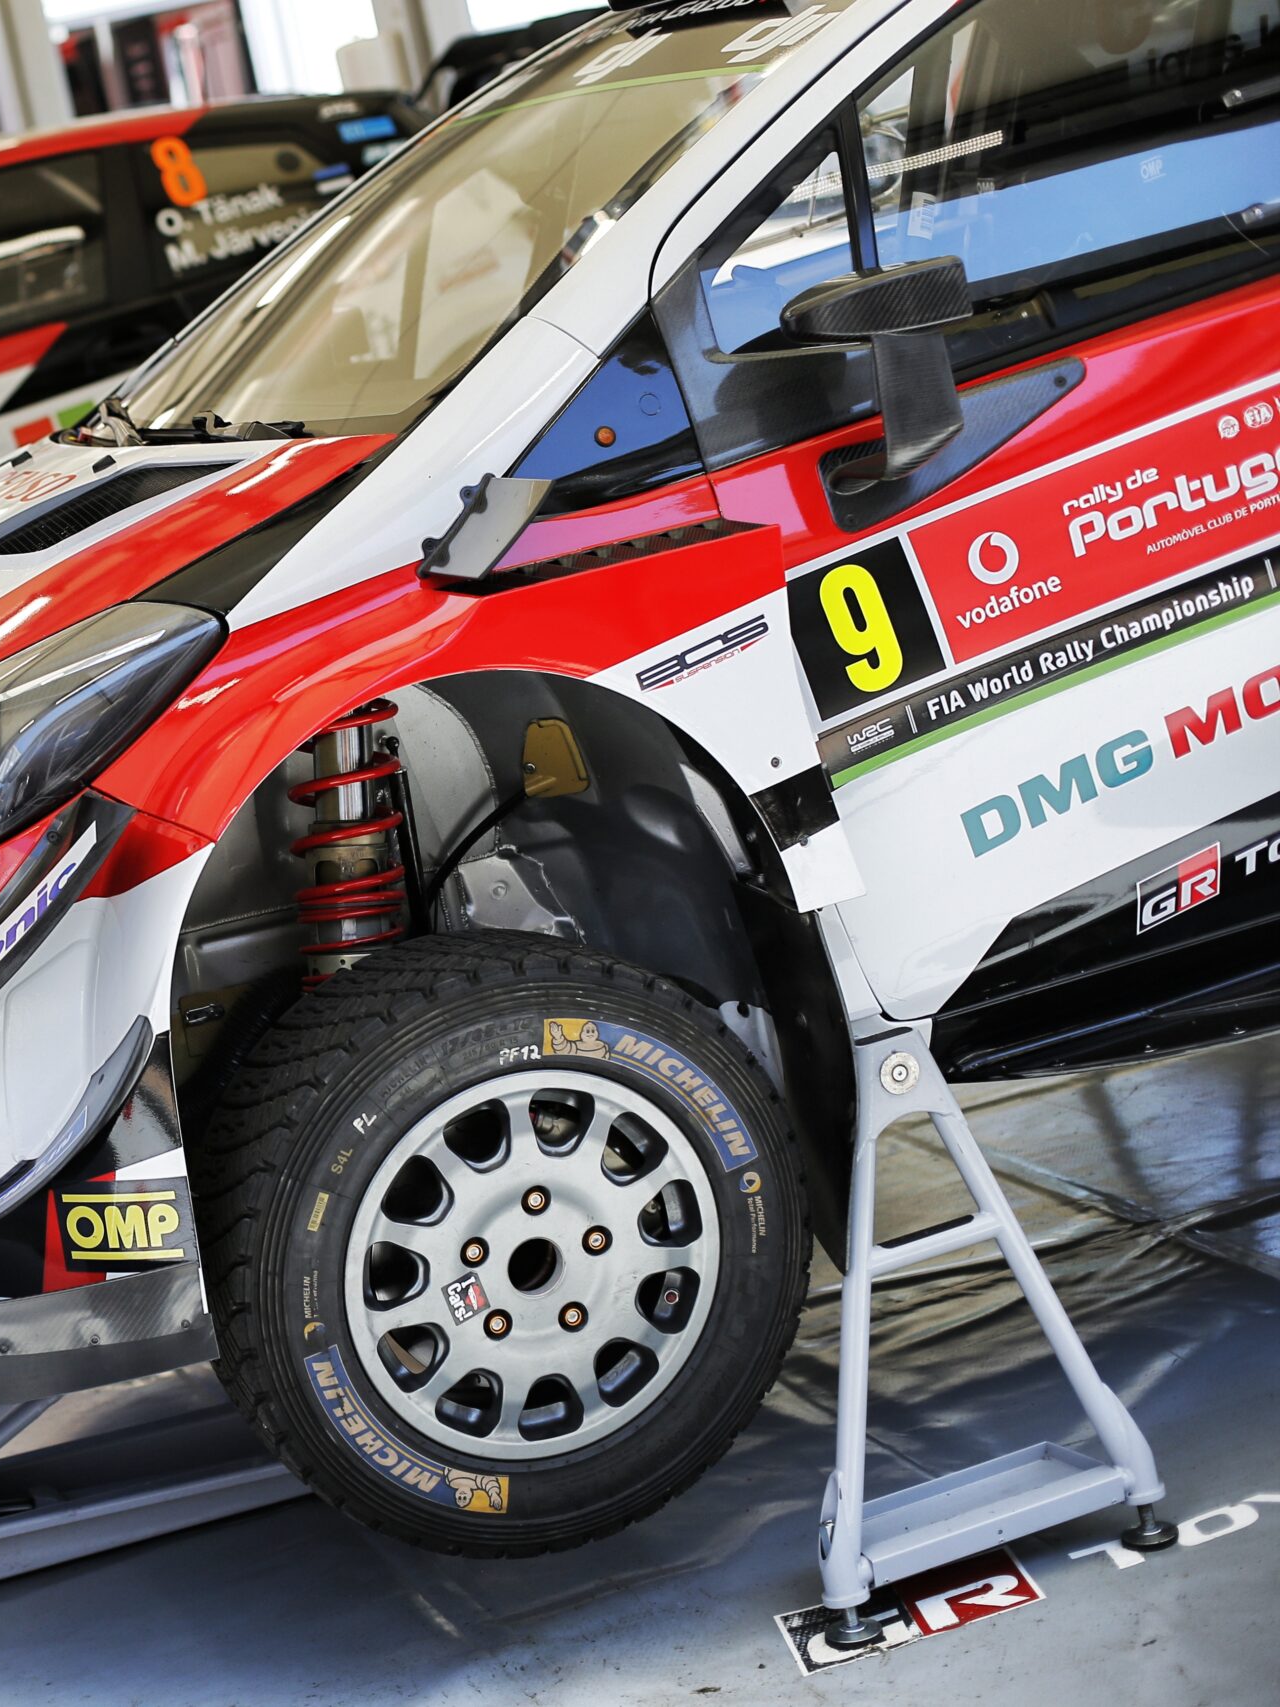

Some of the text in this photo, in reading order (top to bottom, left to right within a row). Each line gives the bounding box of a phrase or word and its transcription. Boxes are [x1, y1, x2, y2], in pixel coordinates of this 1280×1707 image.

[151, 136, 208, 208] 8
[1062, 466, 1159, 516] rally de
[1068, 448, 1280, 558] Portug
[1206, 513, 1233, 530] CLUB
[1233, 506, 1248, 520] DE
[819, 563, 904, 693] 9
[955, 574, 1063, 629] vodafone
[926, 575, 1256, 721] FIA World Rally Championship
[846, 717, 893, 745] WRC
[959, 728, 1154, 858] DMG
[1141, 867, 1217, 926] GR
[613, 1033, 751, 1157] MICHELIN
[66, 1203, 180, 1250] OMP
[754, 1195, 767, 1236] MICHELIN
[303, 1275, 312, 1319] MICHELIN
[447, 1282, 474, 1322] Cars!
[312, 1360, 442, 1494] MICHELIN
